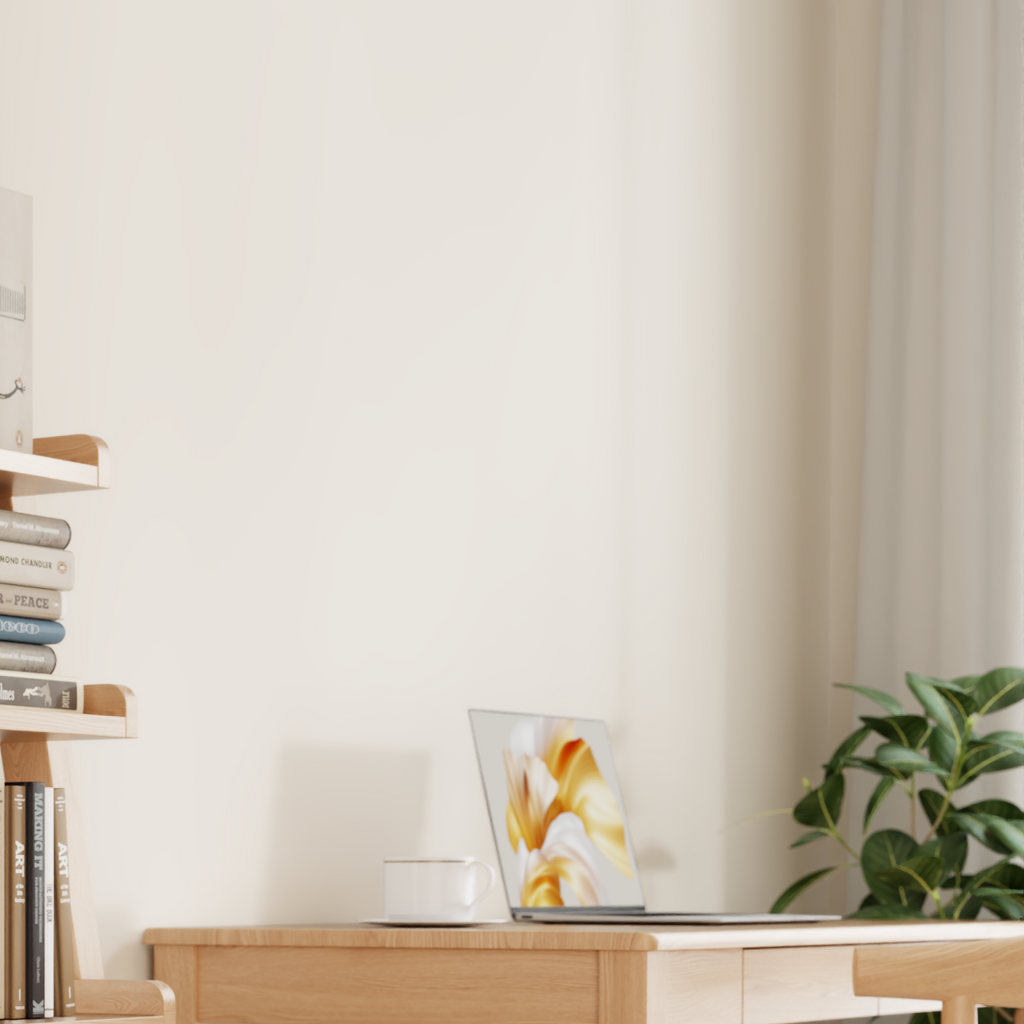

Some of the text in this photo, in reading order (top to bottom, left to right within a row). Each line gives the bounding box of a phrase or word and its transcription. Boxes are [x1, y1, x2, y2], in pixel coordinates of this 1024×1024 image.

[21, 557, 53, 570] CHANDLER
[14, 594, 49, 610] PEACE
[34, 792, 43, 870] MAKING IT
[15, 841, 24, 877] ART
[58, 842, 69, 878] ART
